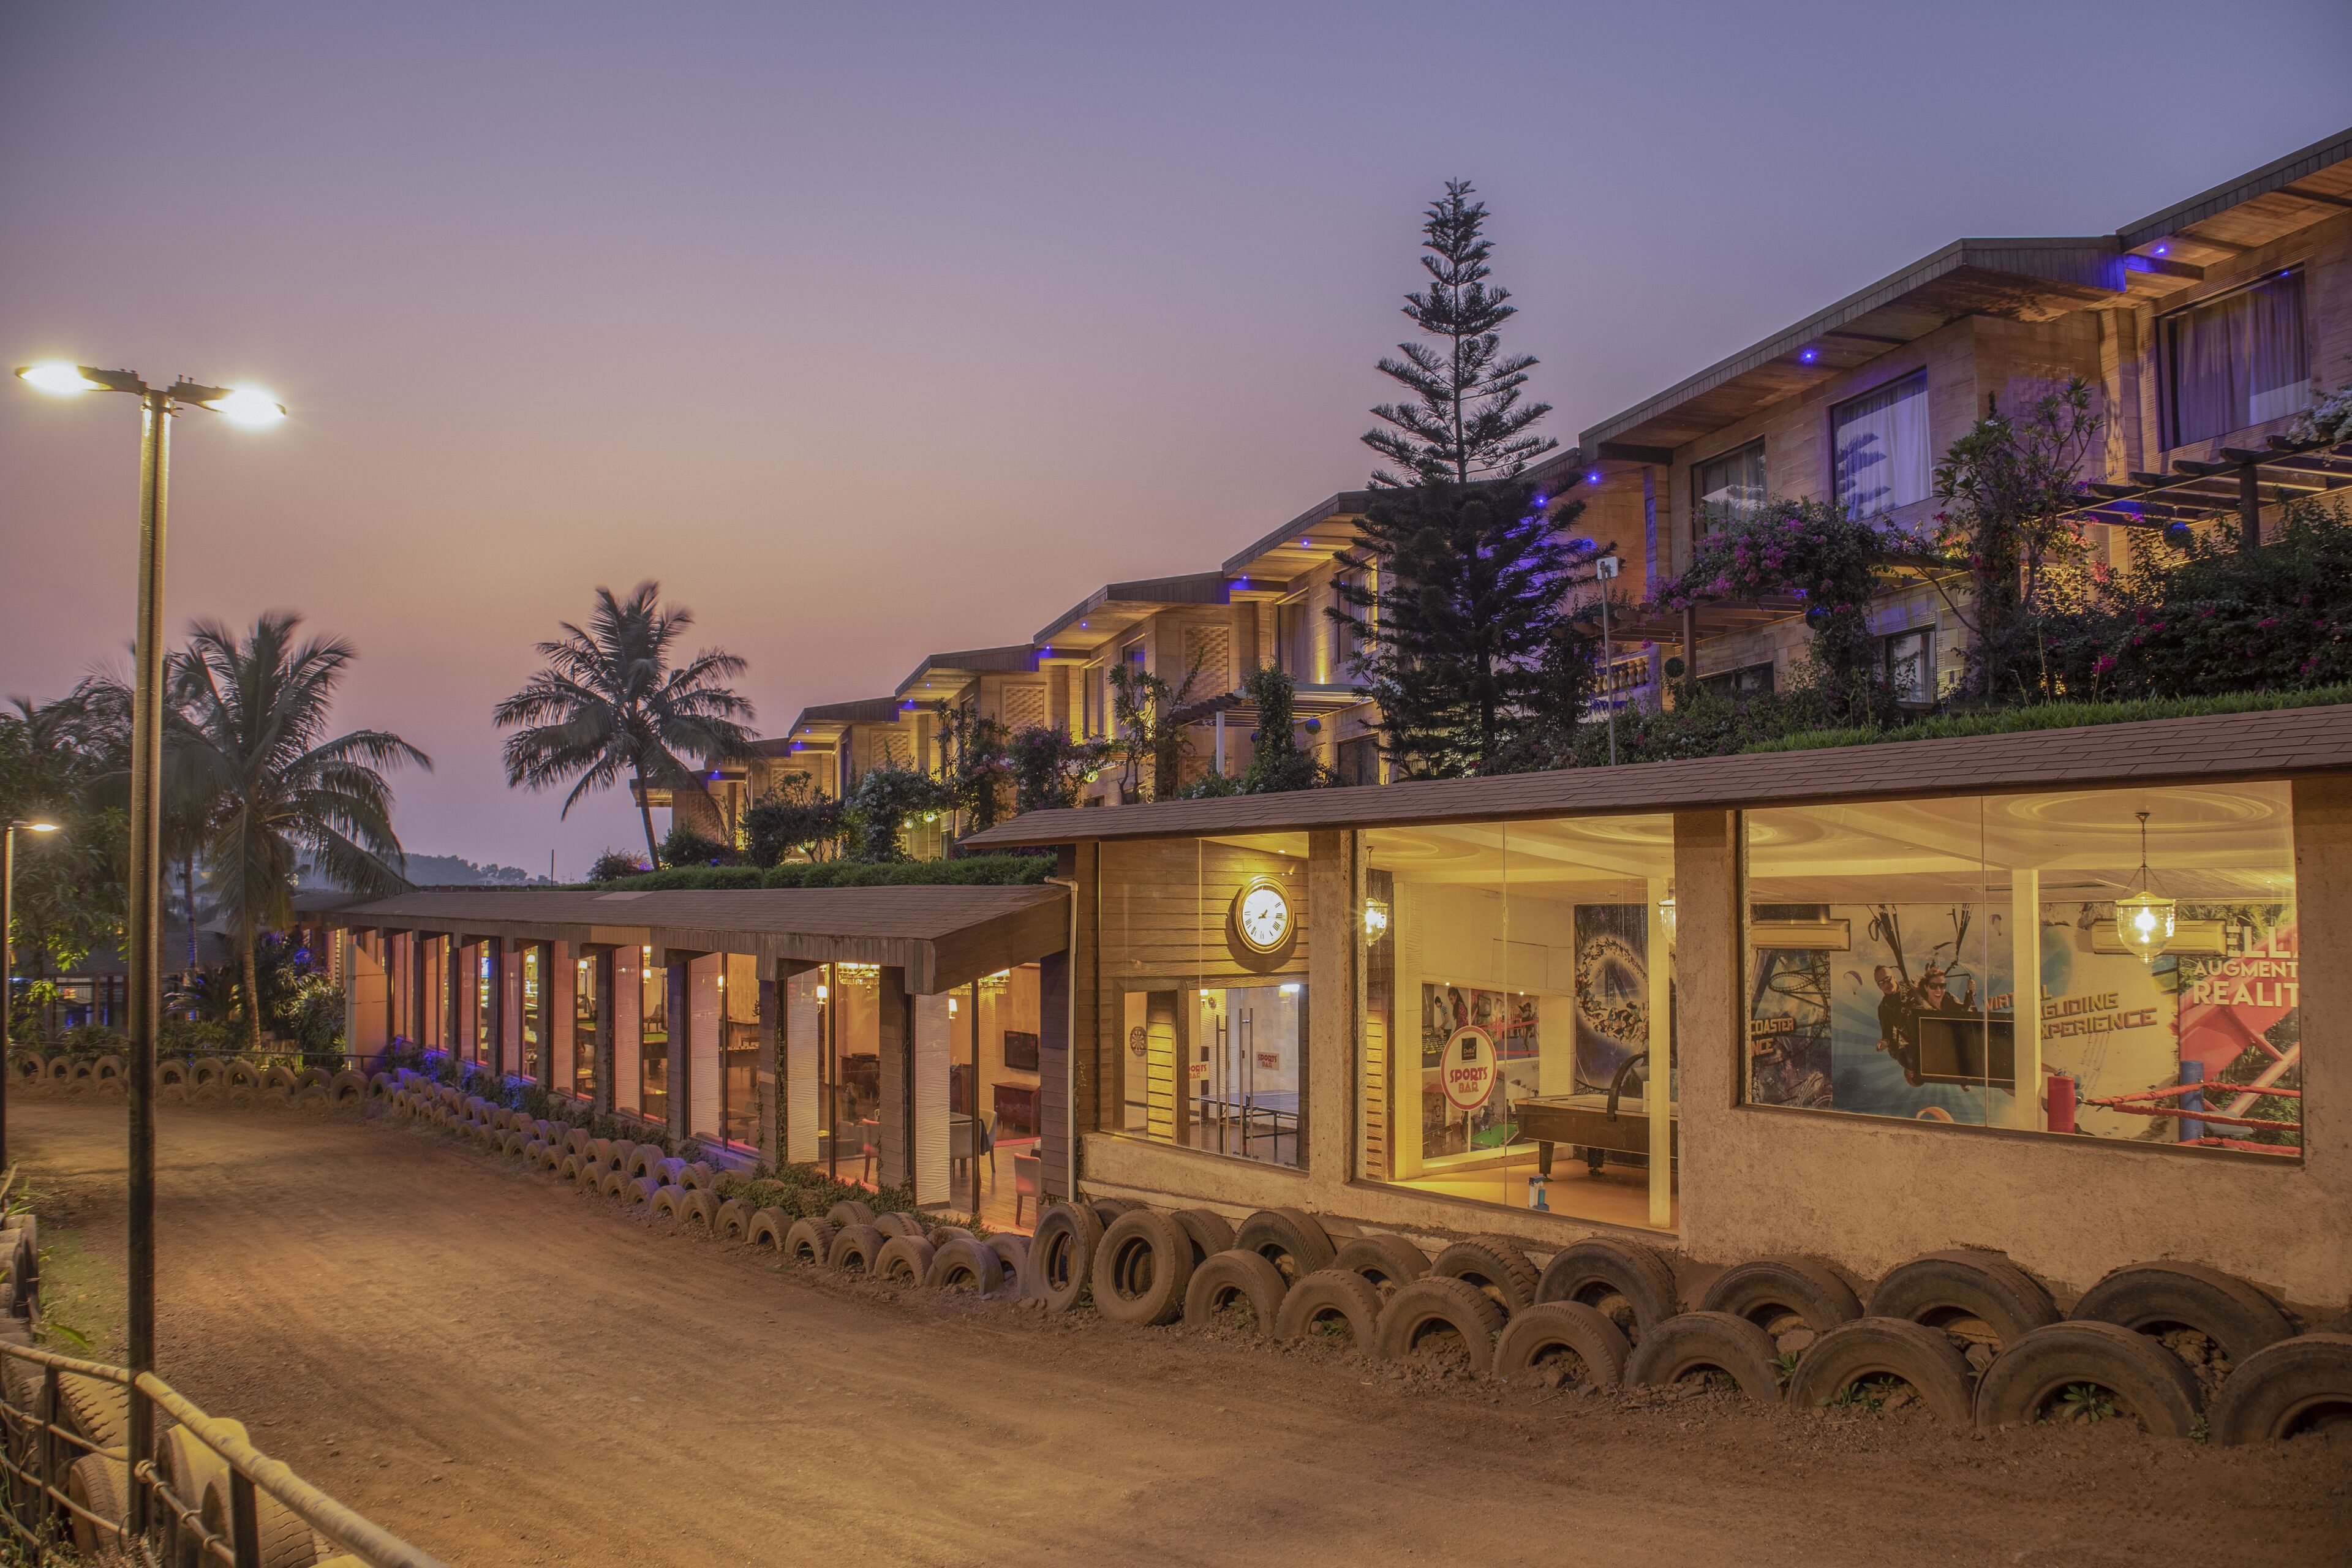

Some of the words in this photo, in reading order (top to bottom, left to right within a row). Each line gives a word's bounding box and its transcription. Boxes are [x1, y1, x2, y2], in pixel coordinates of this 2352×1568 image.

[2226, 926, 2298, 959] ELL
[2193, 960, 2299, 978] AUGMENT
[2193, 980, 2299, 1008] REALIT
[2041, 992, 2119, 1020] GLIDING
[2041, 1007, 2158, 1040] XPERIENCE
[1257, 1054, 1277, 1063] SPORTS
[1450, 1066, 1488, 1084] SPORTS
[1458, 1082, 1479, 1094] BAR
